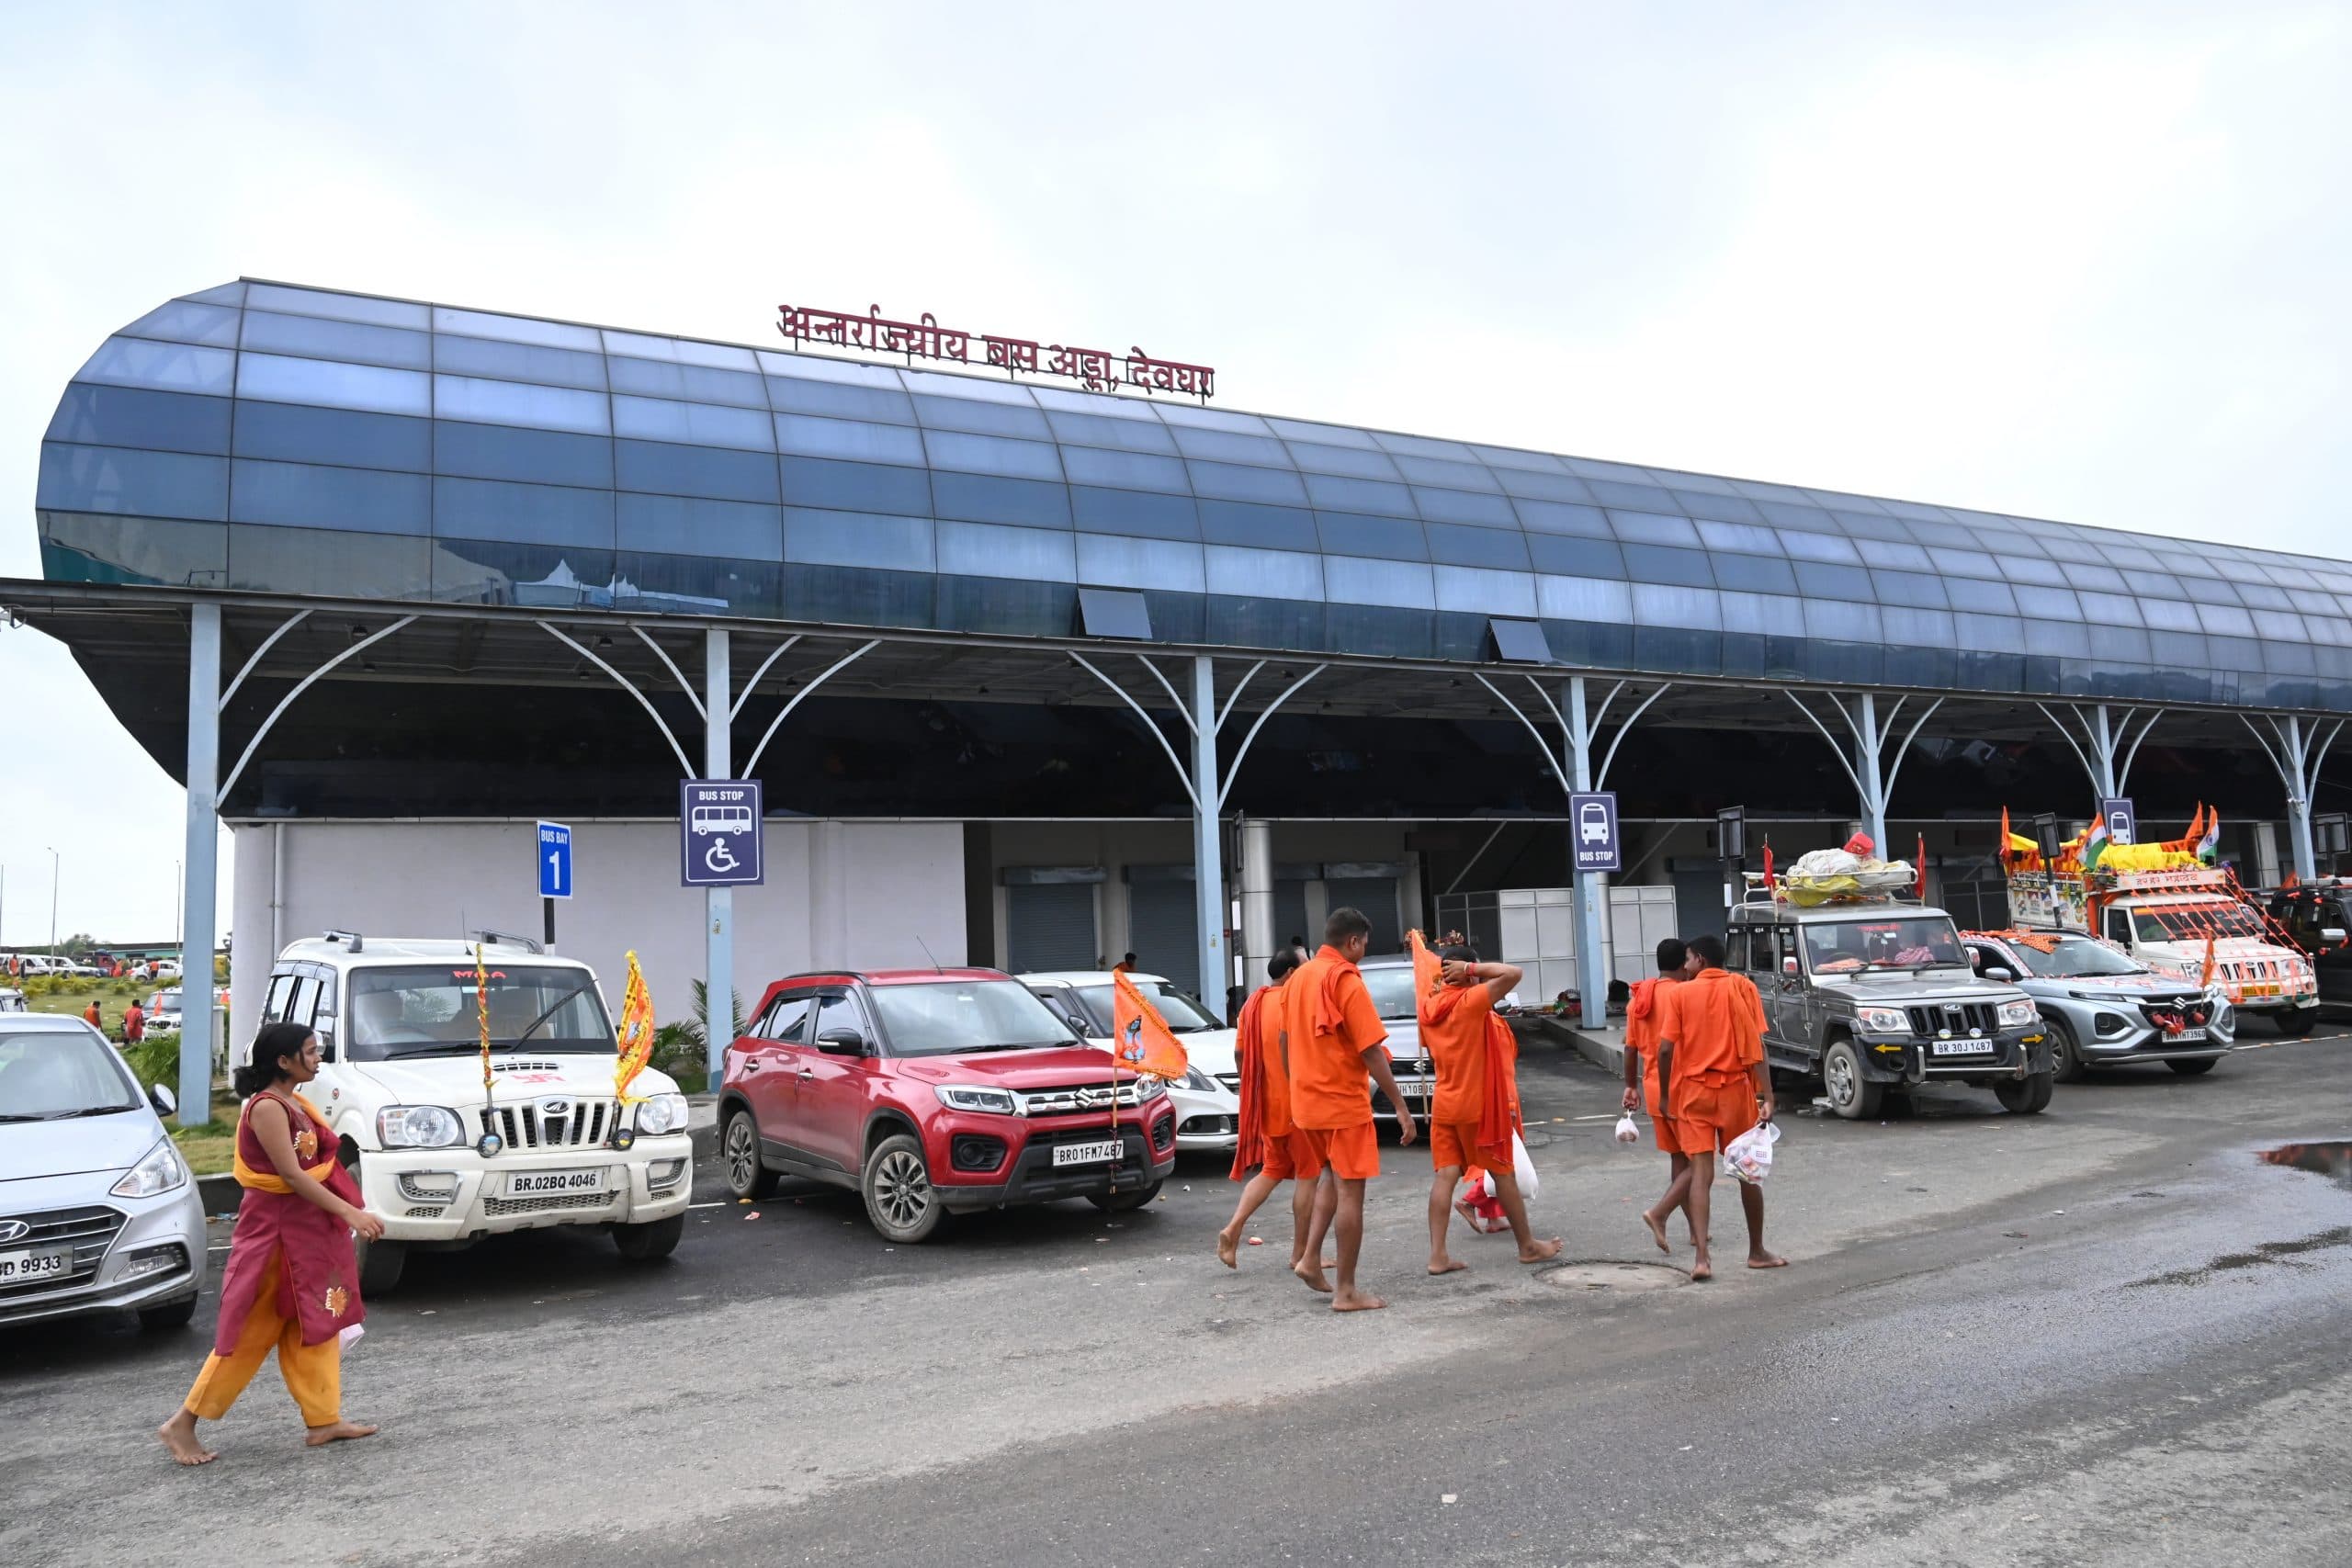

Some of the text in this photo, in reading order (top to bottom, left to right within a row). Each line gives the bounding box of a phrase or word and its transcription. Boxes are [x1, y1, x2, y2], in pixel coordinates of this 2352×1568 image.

[980, 334, 1039, 373] बस
[1126, 345, 1215, 398] देवघर
[699, 791, 744, 801] BUS STOP
[540, 829, 568, 845] BUS BAY
[1579, 851, 1613, 862] BUS STOP
[548, 851, 560, 890] 1
[1938, 1041, 1991, 1054] BR 30J 1487
[514, 1173, 596, 1191] BR.02BQ 4046
[0, 1255, 61, 1276] D 9933
